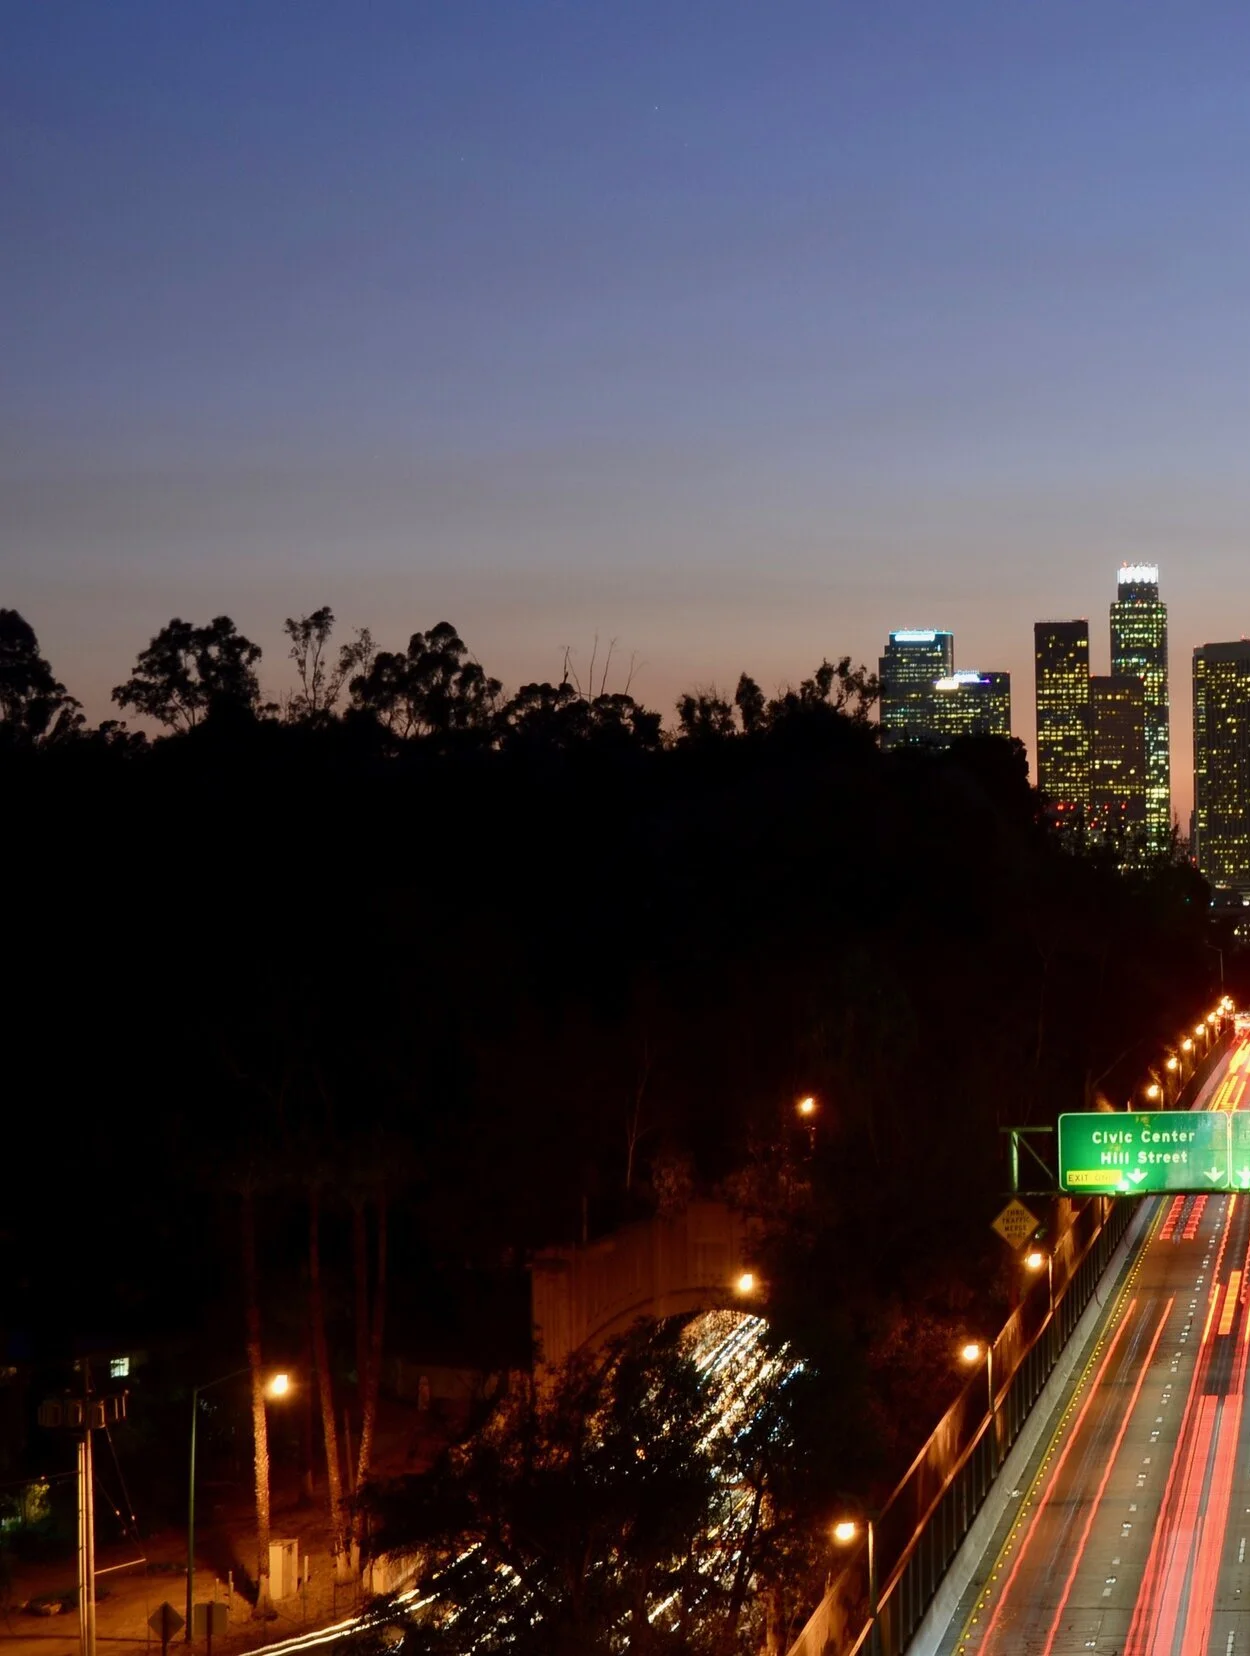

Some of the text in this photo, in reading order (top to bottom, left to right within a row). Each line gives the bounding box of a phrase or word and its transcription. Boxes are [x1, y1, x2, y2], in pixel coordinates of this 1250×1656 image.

[1092, 1131, 1195, 1144] Civic Center
[1101, 1152, 1188, 1165] Hill Street
[1068, 1174, 1089, 1183] EXIT
